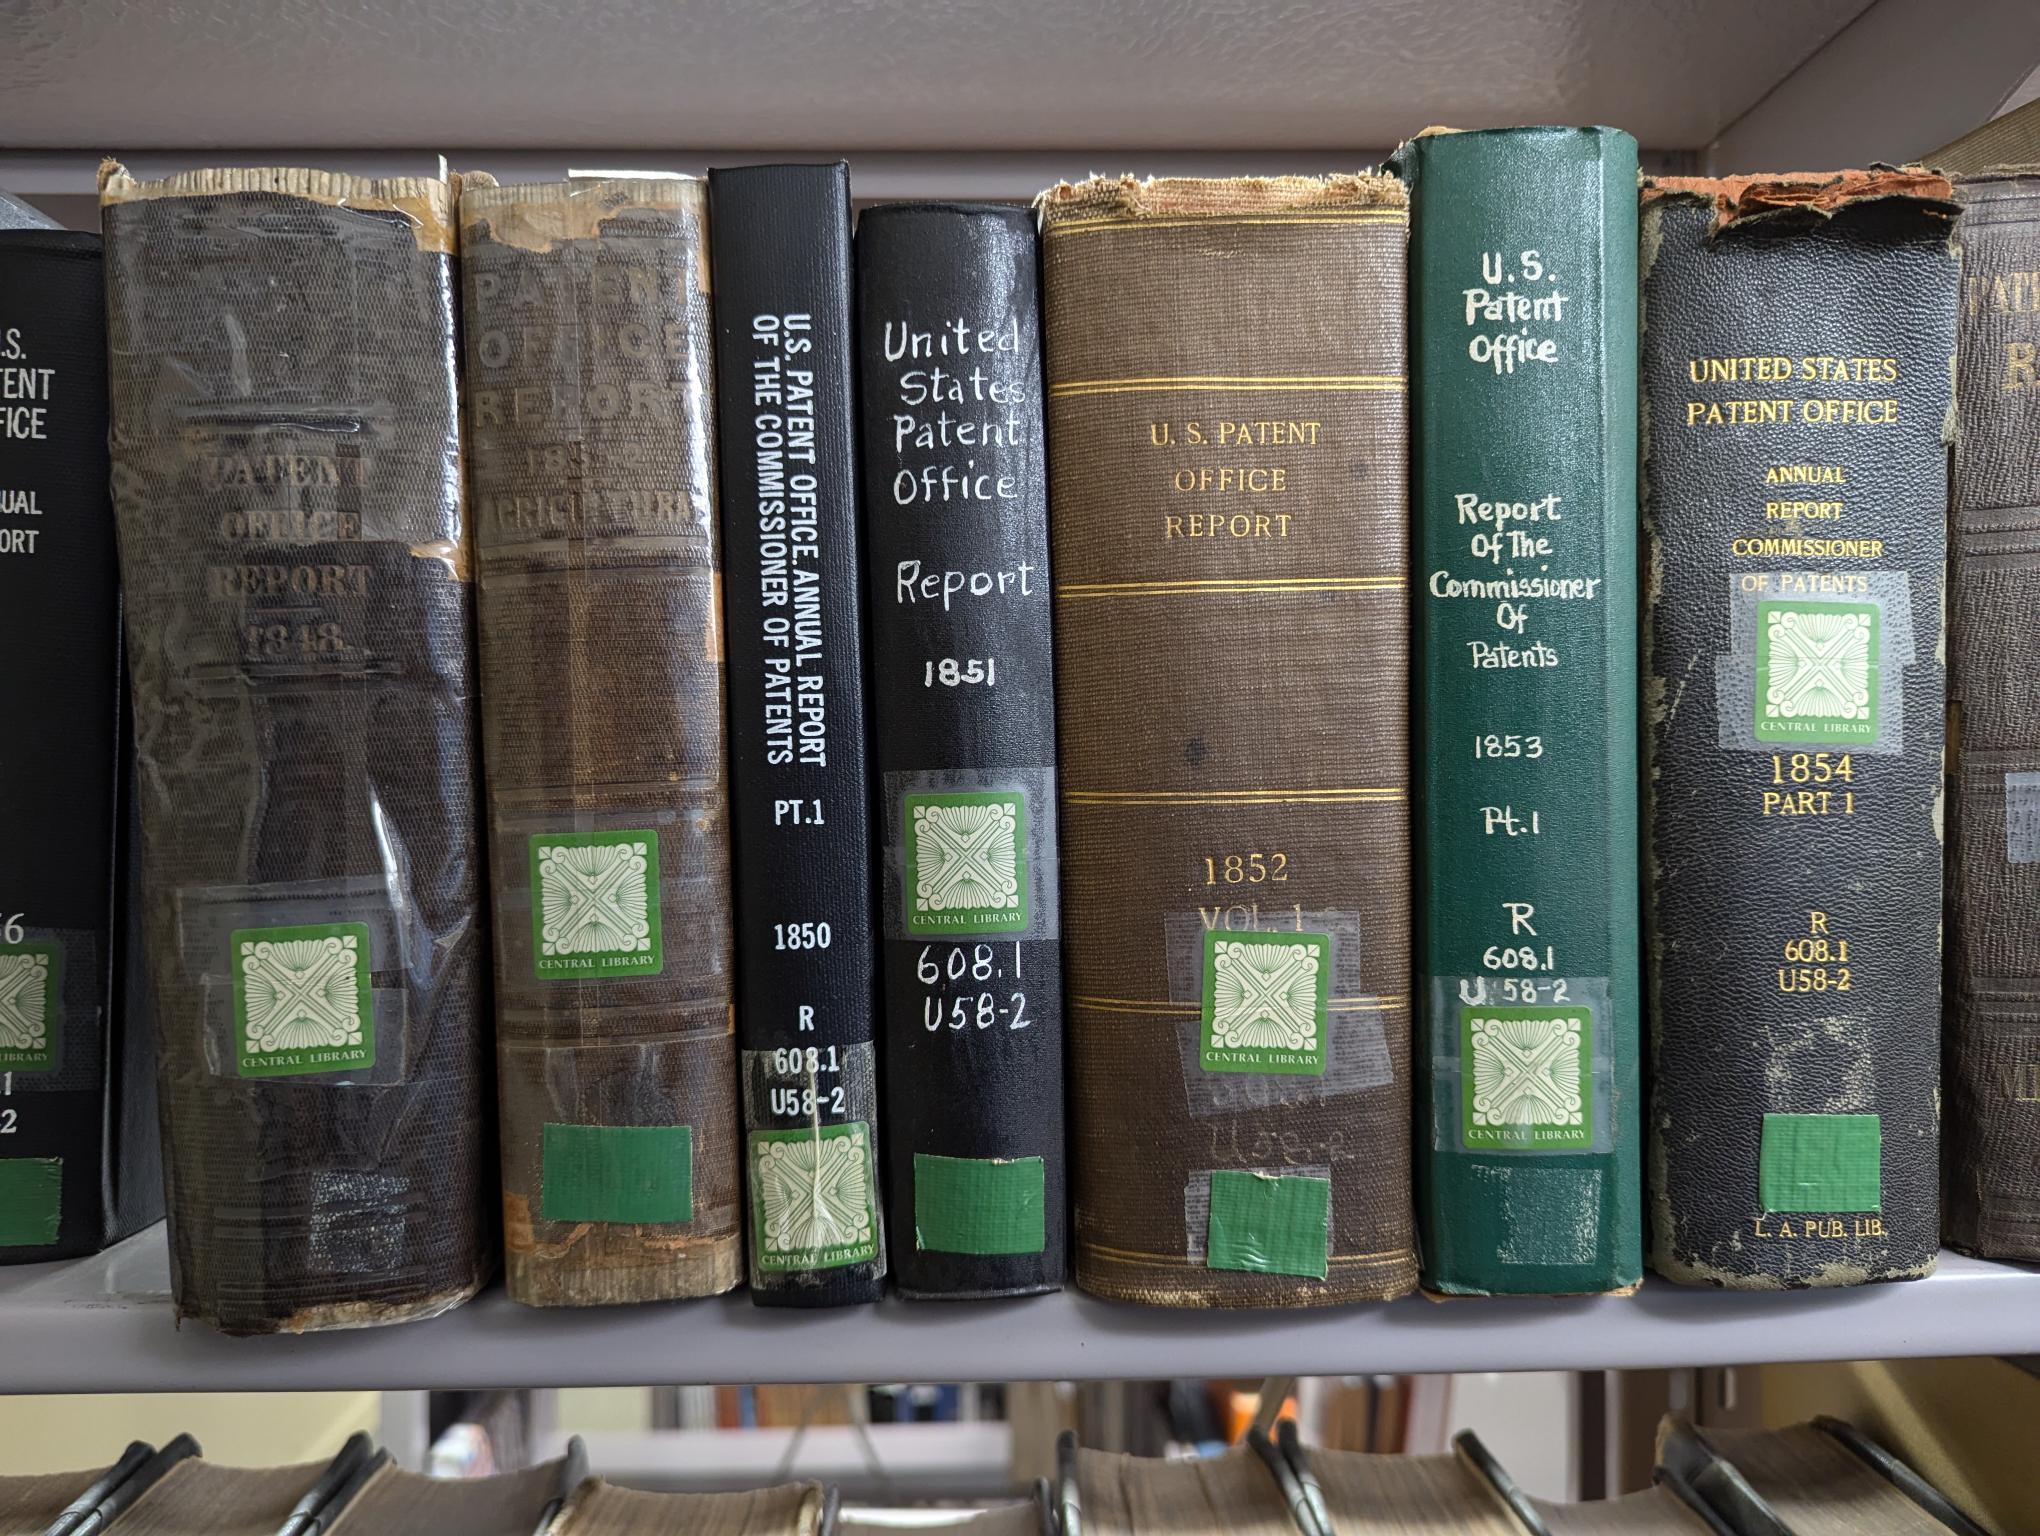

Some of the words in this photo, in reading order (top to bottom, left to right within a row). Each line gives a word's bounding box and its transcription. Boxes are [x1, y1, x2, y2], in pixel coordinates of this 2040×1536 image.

[1462, 288, 1568, 326] Patent
[753, 314, 780, 346] OF
[784, 313, 812, 361] U.S.
[884, 318, 1020, 362] United
[1468, 327, 1558, 375] Office
[0, 368, 56, 400] ENT
[754, 356, 782, 406] THE
[900, 366, 1026, 405] States
[1690, 358, 1792, 383] UNITED
[1801, 358, 1898, 382] STATES
[786, 370, 816, 465] PATENT
[1687, 401, 1793, 427] PATENT
[1803, 400, 1899, 424] OFFICE
[893, 411, 1020, 452] Patent
[1219, 422, 1321, 445] PATENT
[205, 455, 370, 487] PATENT
[893, 460, 1018, 505] Office
[1175, 469, 1287, 492] OFFICE
[1766, 465, 1846, 484] ANNUAL
[0, 490, 43, 515] UAL
[755, 413, 789, 607] COMMISSIONER
[1456, 493, 1561, 532] Report
[1766, 502, 1843, 520] REPORT
[223, 510, 362, 541] OFFICE
[1166, 514, 1292, 538] REPORT
[1471, 531, 1502, 564] Of
[1506, 530, 1552, 558] The
[1732, 538, 1883, 557] COMMISSIONER
[207, 563, 374, 599] REPORT
[897, 560, 1034, 611] Report
[1430, 564, 1601, 600] Commissioner
[1741, 575, 1769, 593] OF
[1781, 574, 1869, 593] PATENTS
[763, 617, 790, 648] OF
[792, 568, 822, 667] ANNUAL
[1497, 601, 1528, 634] Of
[1466, 641, 1558, 669] Patents
[924, 657, 995, 688] 1851
[765, 658, 793, 765] PATENTS
[797, 675, 826, 767] REPORT
[1760, 721, 1817, 733] CENTRAL
[1823, 723, 1872, 735] LIBRARY
[1475, 735, 1543, 759] 1853
[1772, 752, 1853, 784] 1854
[775, 799, 825, 825] PT.1
[1762, 791, 1831, 815] PART
[1845, 792, 1854, 814] 1
[1204, 854, 1289, 885] 1852
[912, 914, 967, 926] CENTRAL
[973, 912, 1024, 925] LIBRARY
[1502, 902, 1537, 936] R
[1810, 911, 1829, 934] R
[775, 922, 831, 950] 1850
[1784, 939, 1849, 962] 608.1
[539, 959, 596, 971] CENTRAL
[602, 954, 655, 968] LIBRARY
[917, 941, 1021, 985] 608.1
[1483, 946, 1553, 971] 608.1
[1777, 968, 1851, 992] U58-2
[799, 1005, 815, 1031] R
[924, 992, 1031, 1032] U58-2
[242, 1055, 302, 1069] CENTRAL
[311, 1049, 368, 1064] LIBRARY
[774, 1045, 840, 1074] 608.1
[1206, 1050, 1262, 1064] CENTRAL
[1268, 1052, 1319, 1065] LIBRARY
[770, 1087, 846, 1115] U58-2
[1468, 1129, 1527, 1140] CENTRAL
[1534, 1129, 1585, 1140] LIBRARY
[1754, 1219, 1771, 1238] L.
[1779, 1221, 1798, 1239] A.
[1805, 1219, 1848, 1239] PUB.
[761, 1253, 817, 1265] CENTRAL
[823, 1244, 875, 1262] LIBRARY
